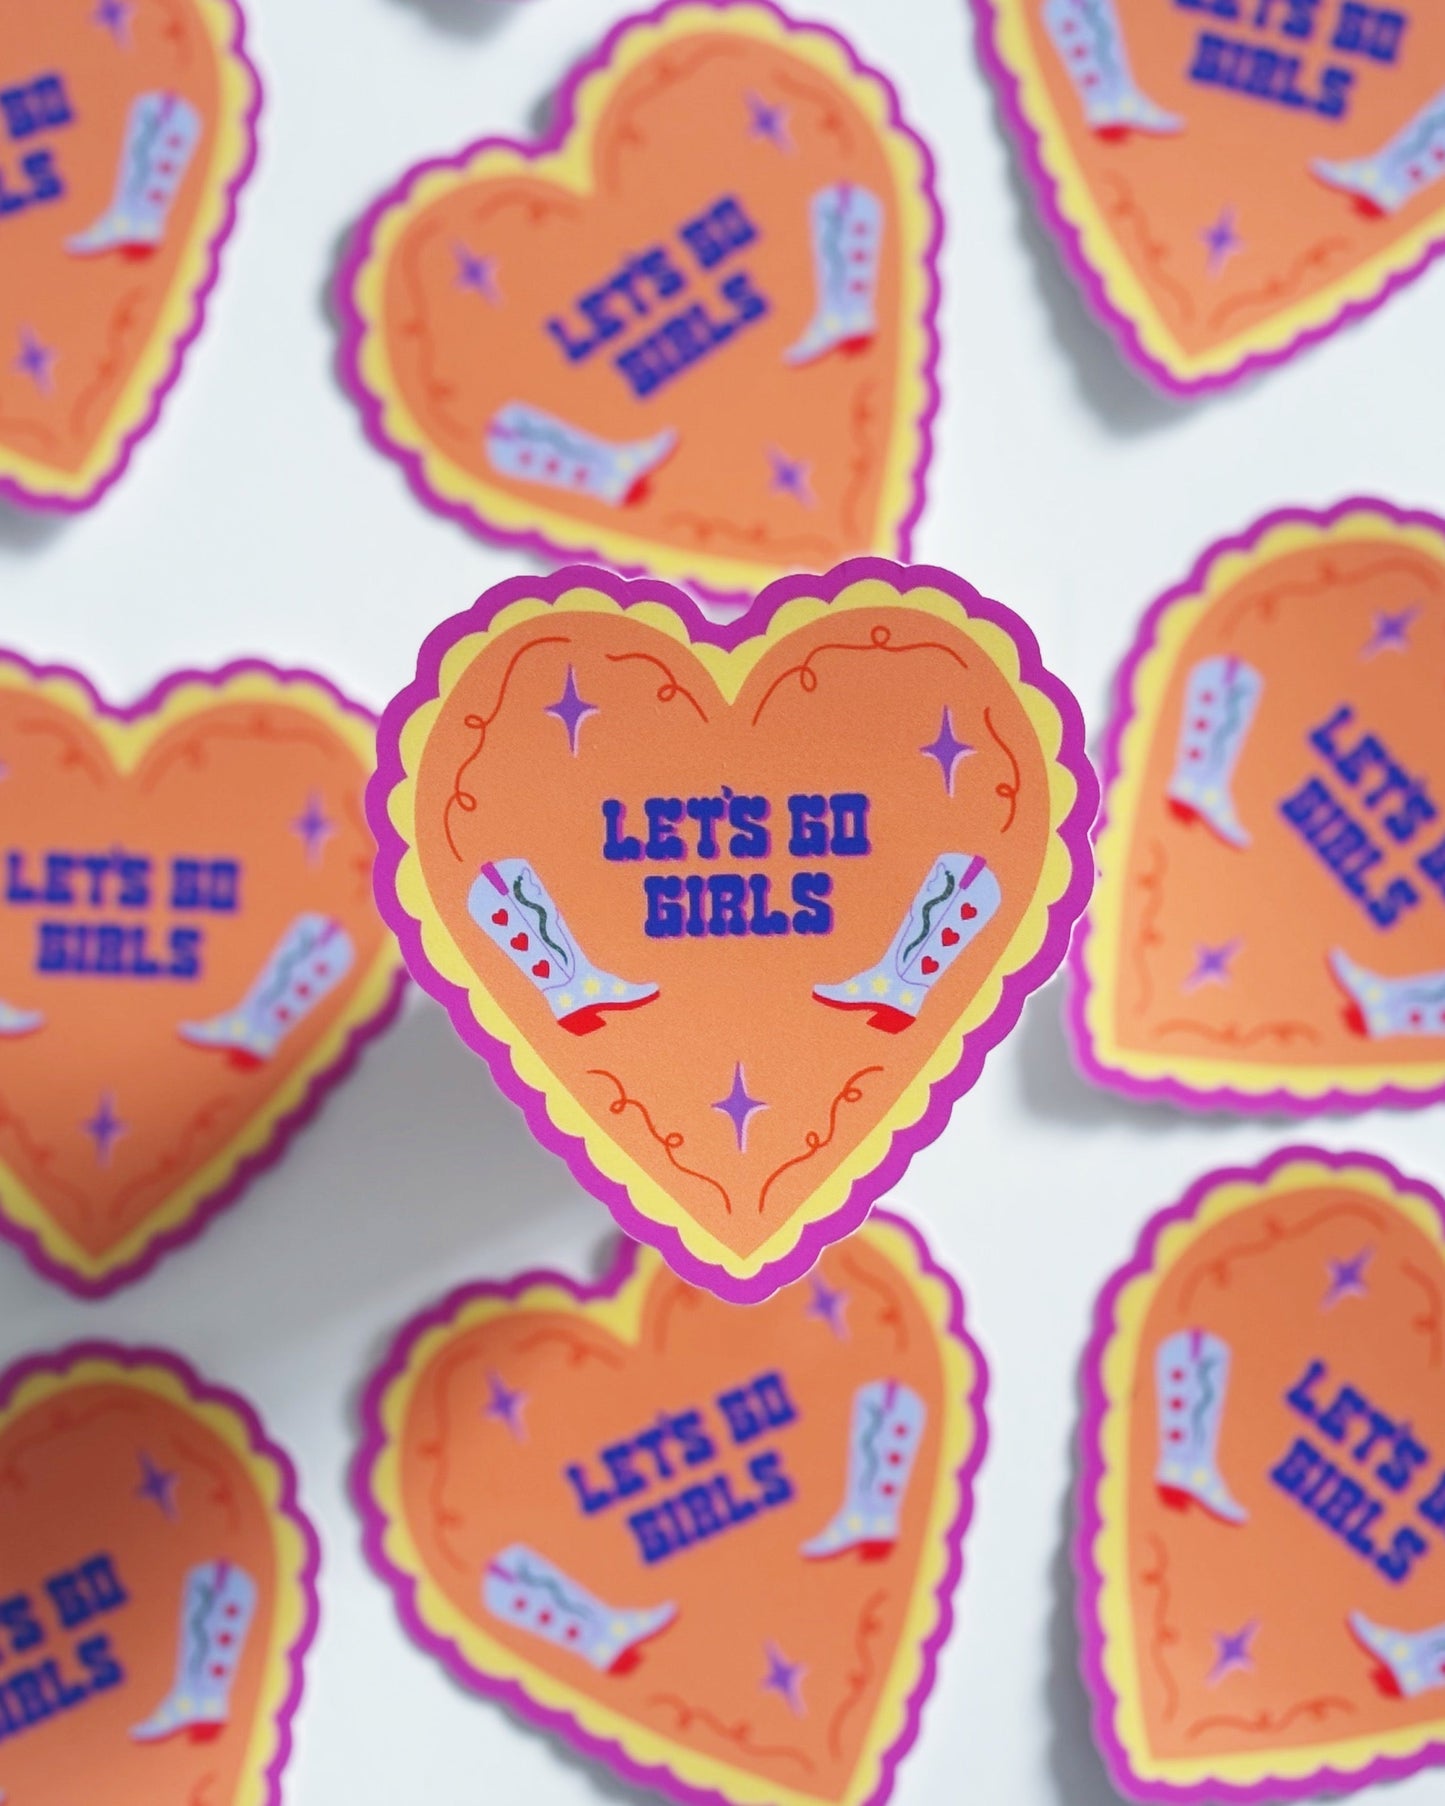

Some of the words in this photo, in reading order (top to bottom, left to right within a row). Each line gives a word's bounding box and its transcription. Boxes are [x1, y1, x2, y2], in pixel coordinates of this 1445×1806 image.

[615, 273, 768, 398] GIRLS
[602, 784, 771, 861] LET'S
[787, 792, 872, 857] GO
[1280, 776, 1420, 929] GIRLS
[170, 858, 240, 912] GO
[644, 872, 834, 938] GIRLS
[37, 921, 202, 979] GIRLS
[716, 1371, 797, 1445] GO
[627, 1450, 794, 1565] GIRLS
[1270, 1436, 1429, 1582] GIRLS
[45, 1555, 127, 1630] GO
